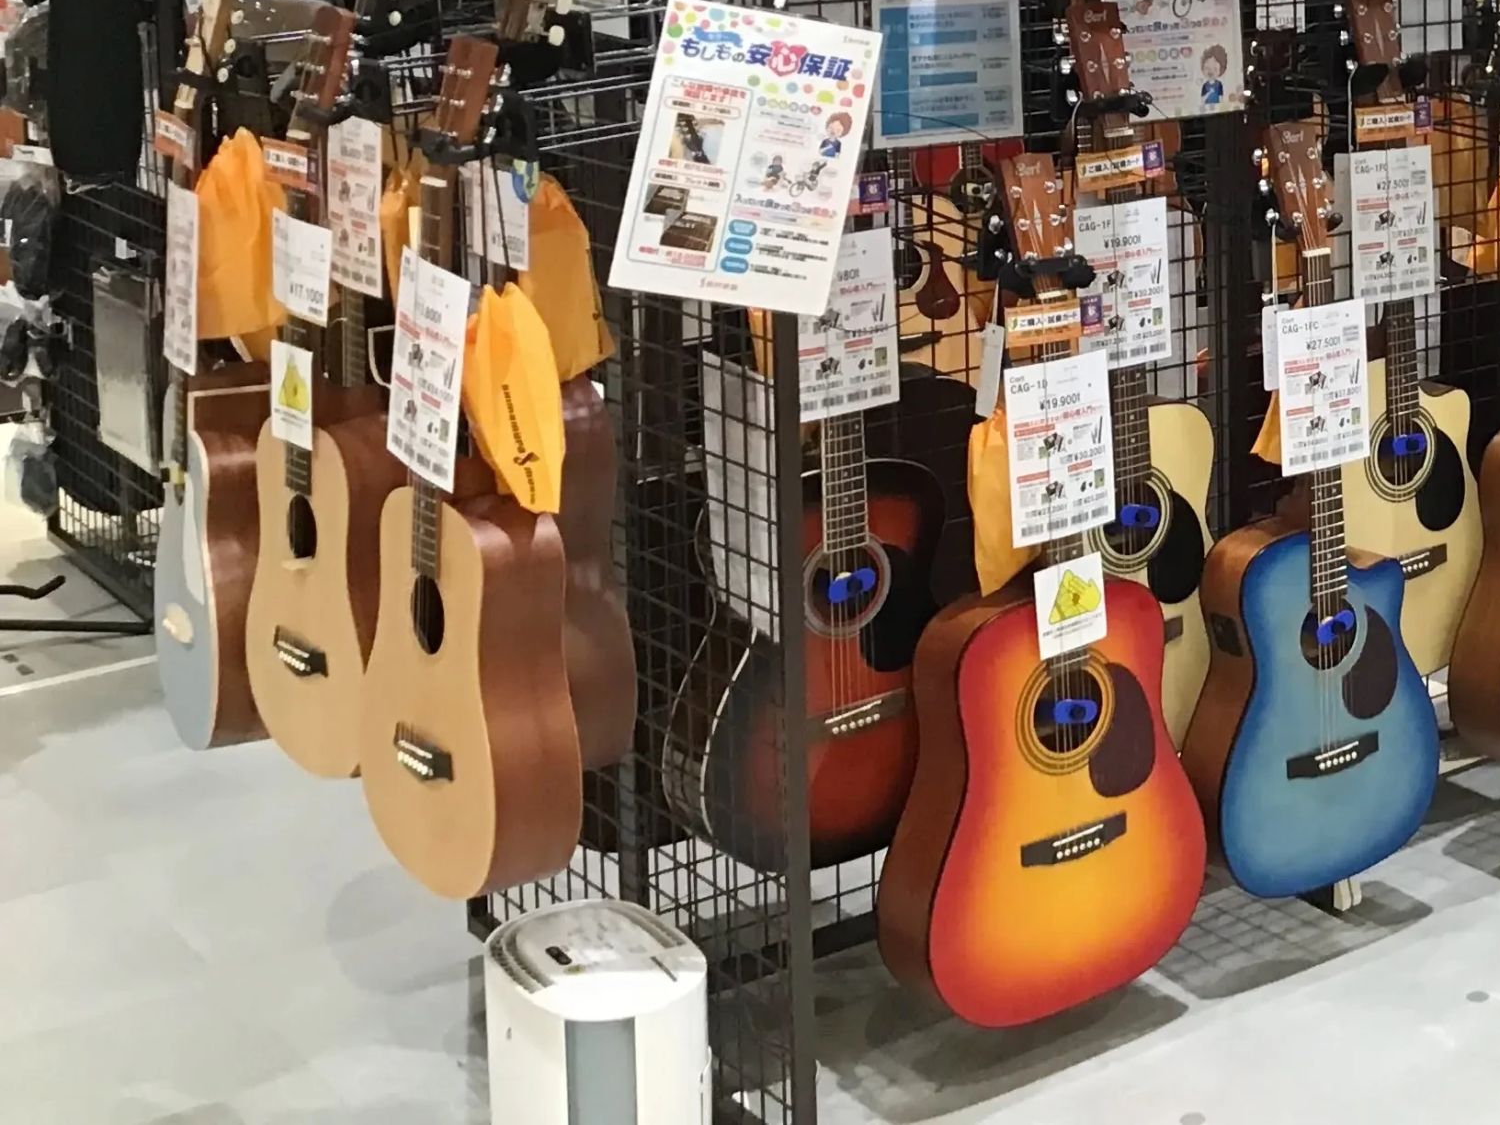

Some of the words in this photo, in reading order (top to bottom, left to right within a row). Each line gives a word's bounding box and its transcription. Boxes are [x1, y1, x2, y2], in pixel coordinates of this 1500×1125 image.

[681, 38, 854, 82] もしもの安心保証
[1079, 219, 1112, 233] CAG-1F
